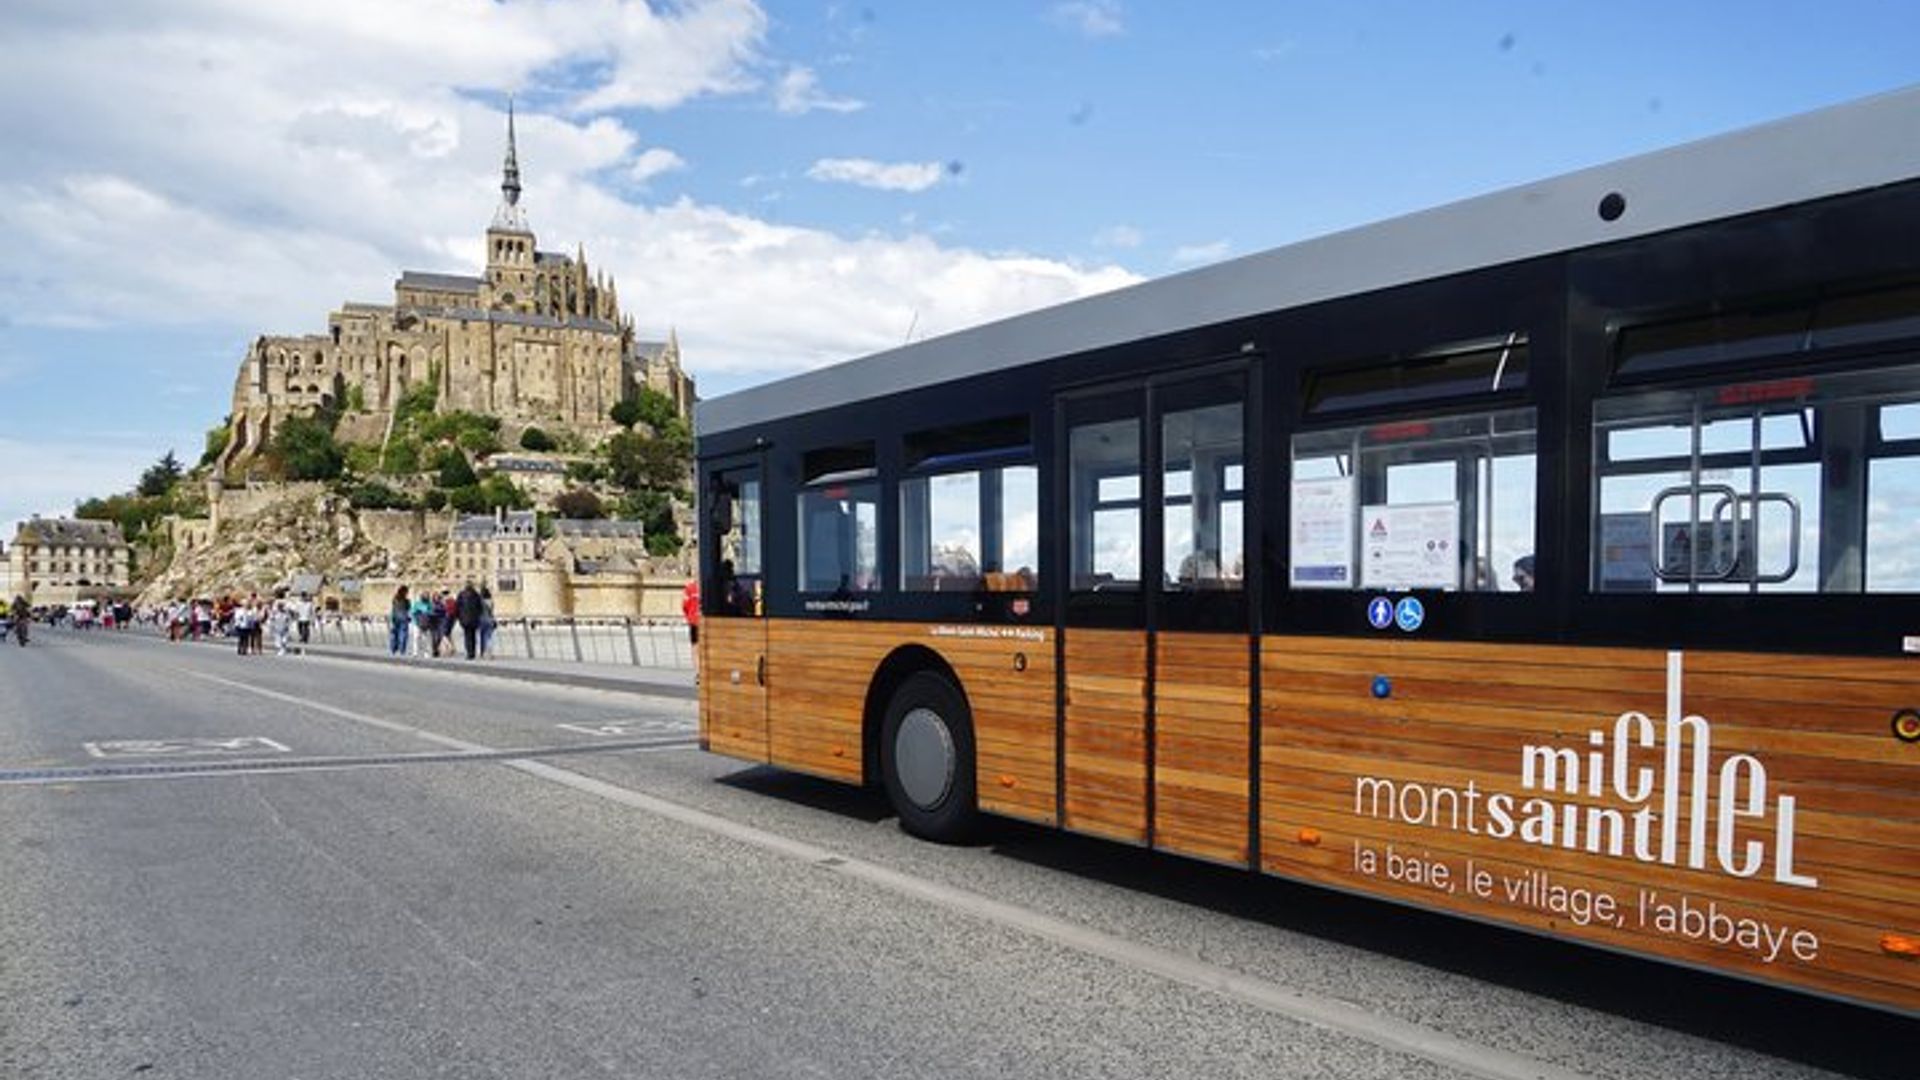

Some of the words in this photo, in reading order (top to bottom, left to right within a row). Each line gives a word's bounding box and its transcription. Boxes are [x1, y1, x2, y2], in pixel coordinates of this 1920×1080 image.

[1353, 840, 1376, 874] la
[1386, 844, 1456, 894] baie,
[1466, 861, 1493, 898] le
[1503, 871, 1624, 927] village,
[1638, 890, 1819, 963] l'abbaye
